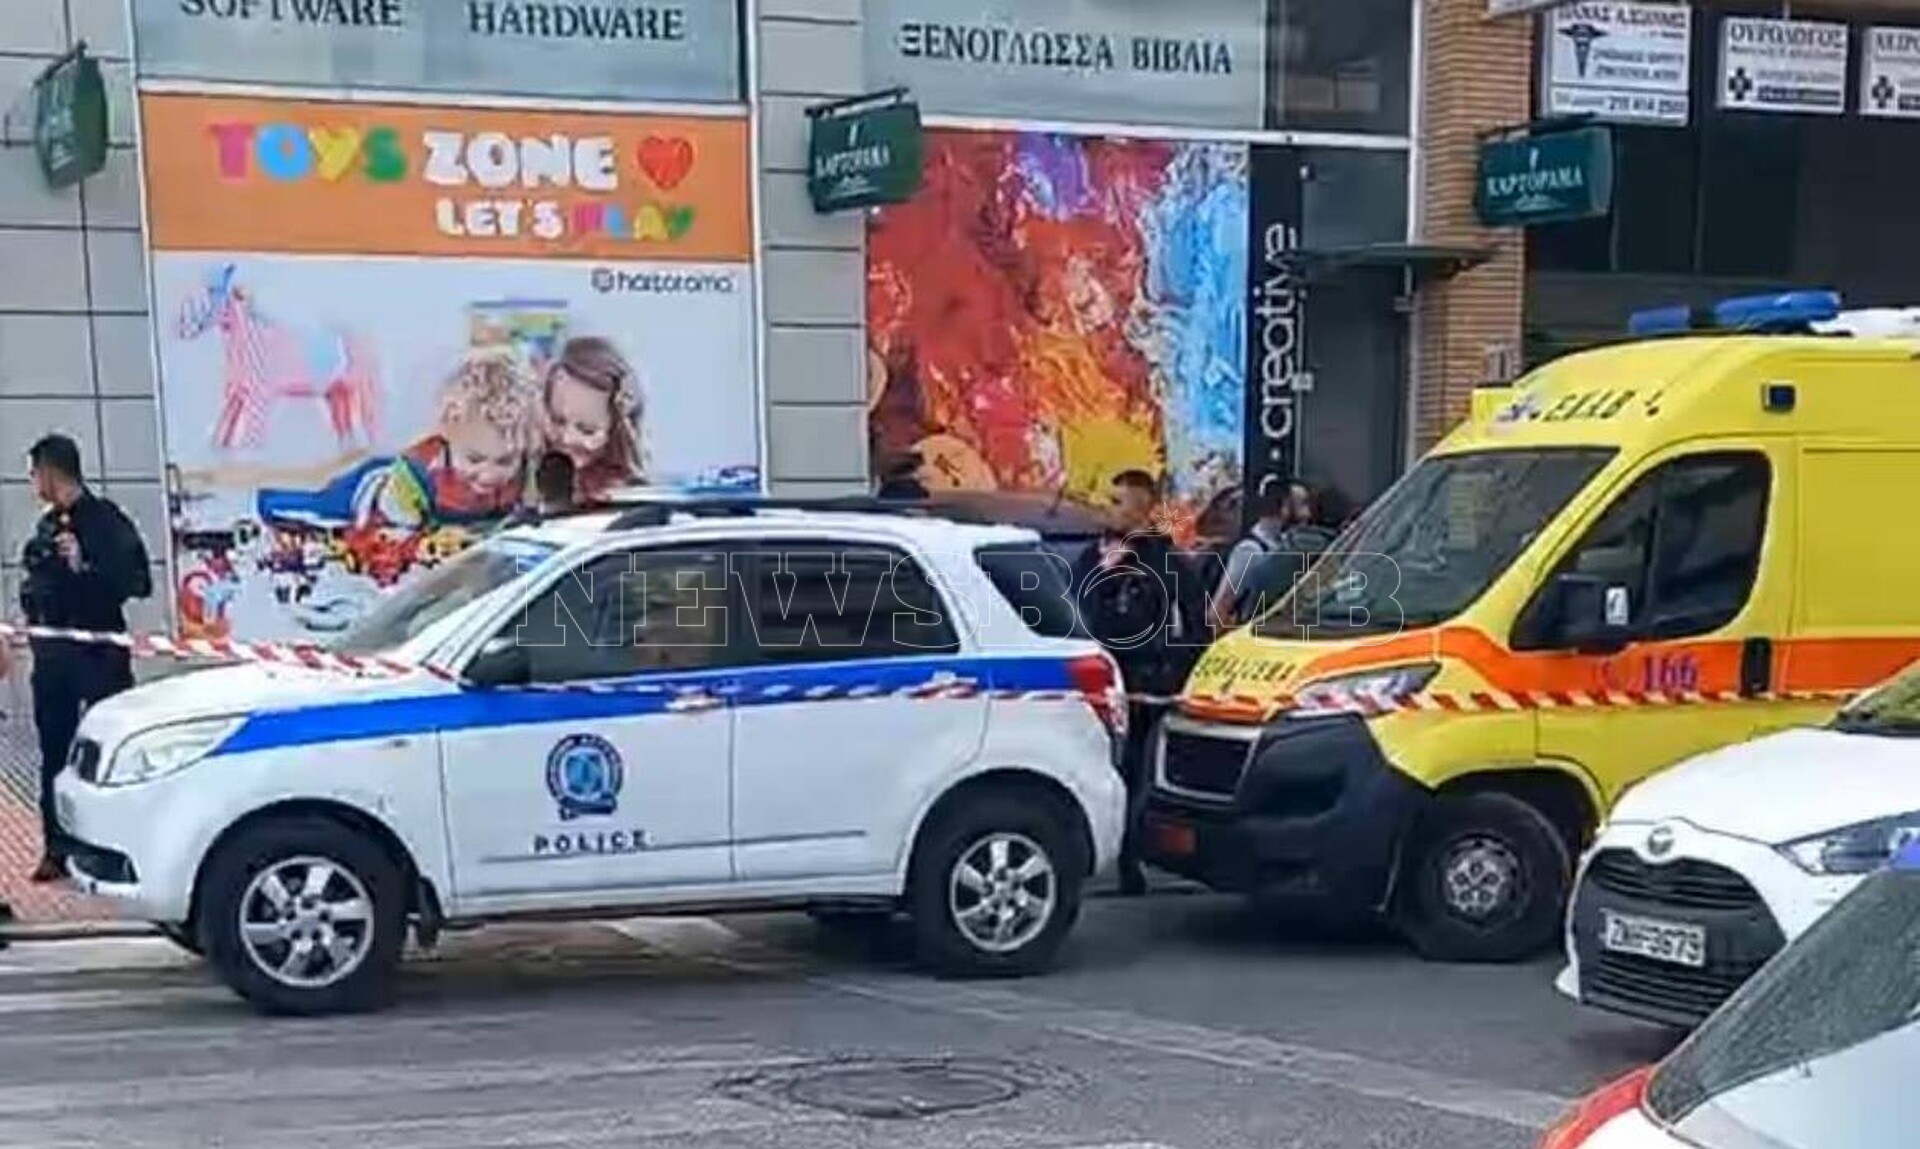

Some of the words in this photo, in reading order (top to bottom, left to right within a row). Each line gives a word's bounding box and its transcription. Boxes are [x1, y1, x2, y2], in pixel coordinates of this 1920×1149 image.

[467, 1, 685, 40] HARDWARE
[900, 23, 1115, 70] ΞΕΝΟΓΛΩΣΣΑ
[1131, 36, 1233, 75] ΒΙΒΛΙΑ
[208, 123, 408, 183] TOYS
[423, 132, 619, 191] ZONE
[435, 198, 564, 239] LET'S
[570, 202, 697, 241] PLAY
[533, 828, 648, 854] POLICE
